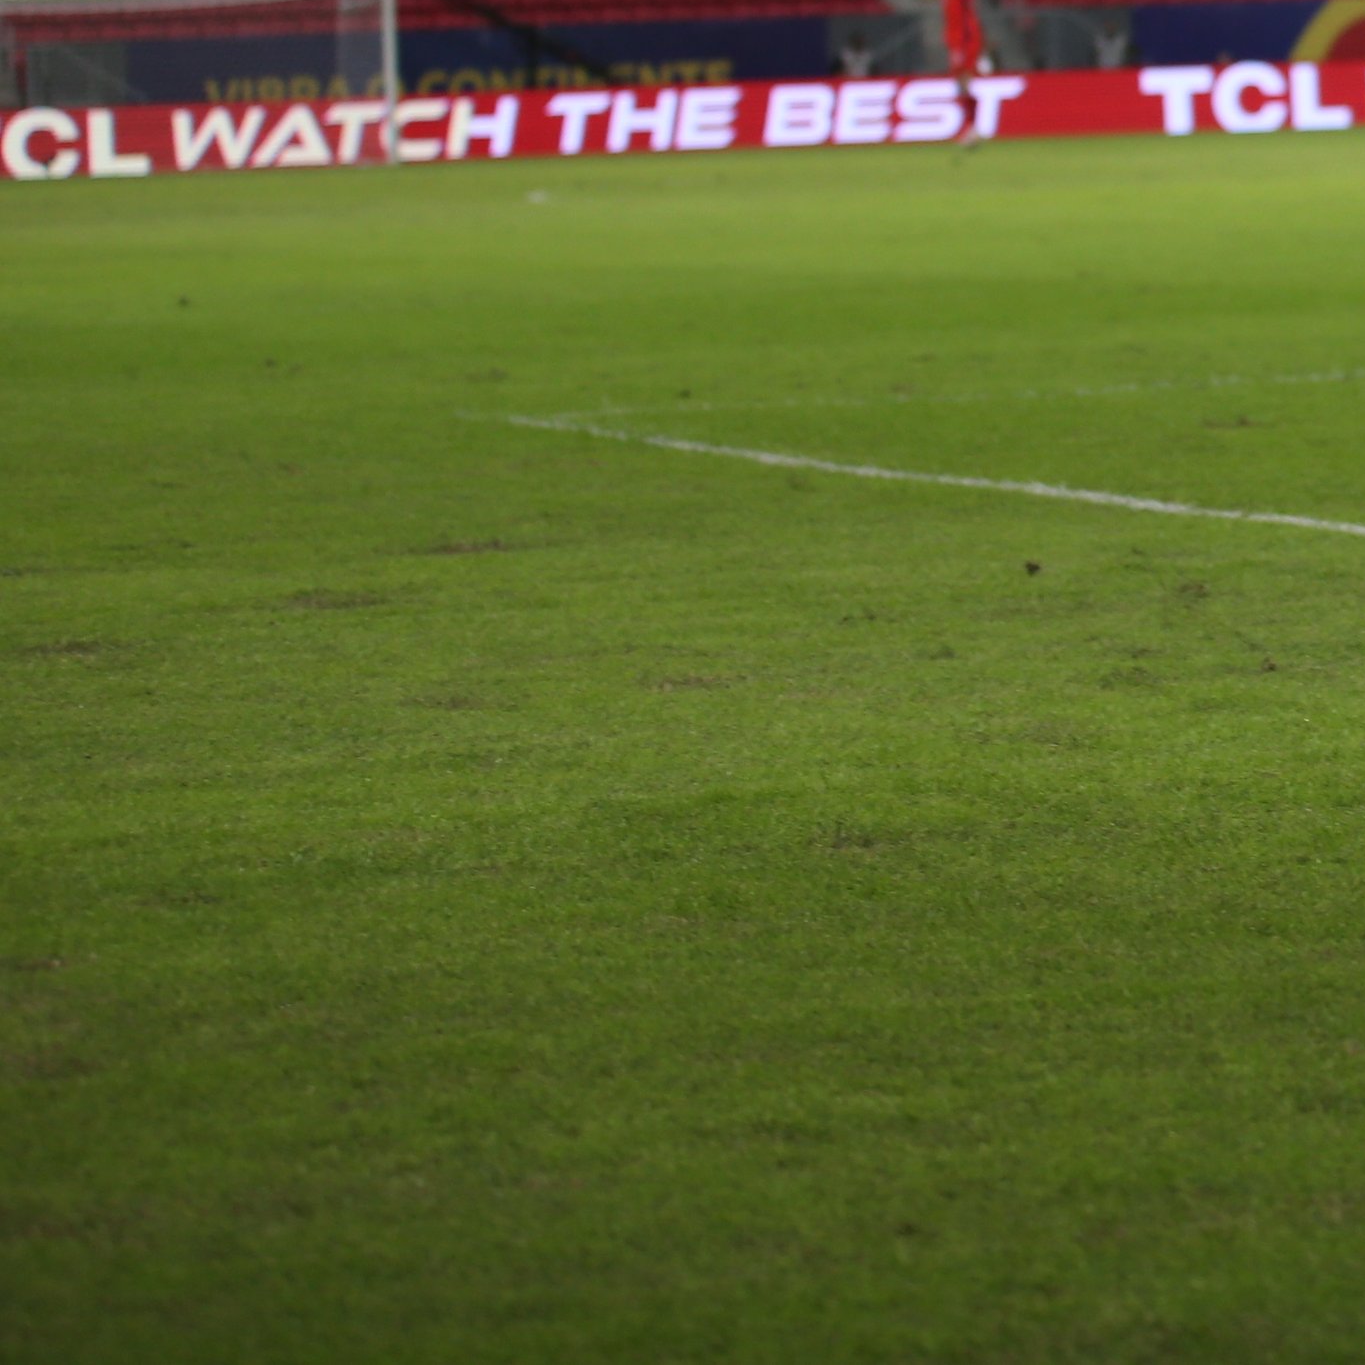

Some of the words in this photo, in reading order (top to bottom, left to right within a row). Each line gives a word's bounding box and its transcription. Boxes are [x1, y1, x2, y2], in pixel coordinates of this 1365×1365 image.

[0, 104, 154, 181] CL
[170, 93, 521, 173] WATCH
[545, 85, 743, 157] THE
[761, 75, 1028, 148] BEST
[1138, 60, 1355, 136] TCL
